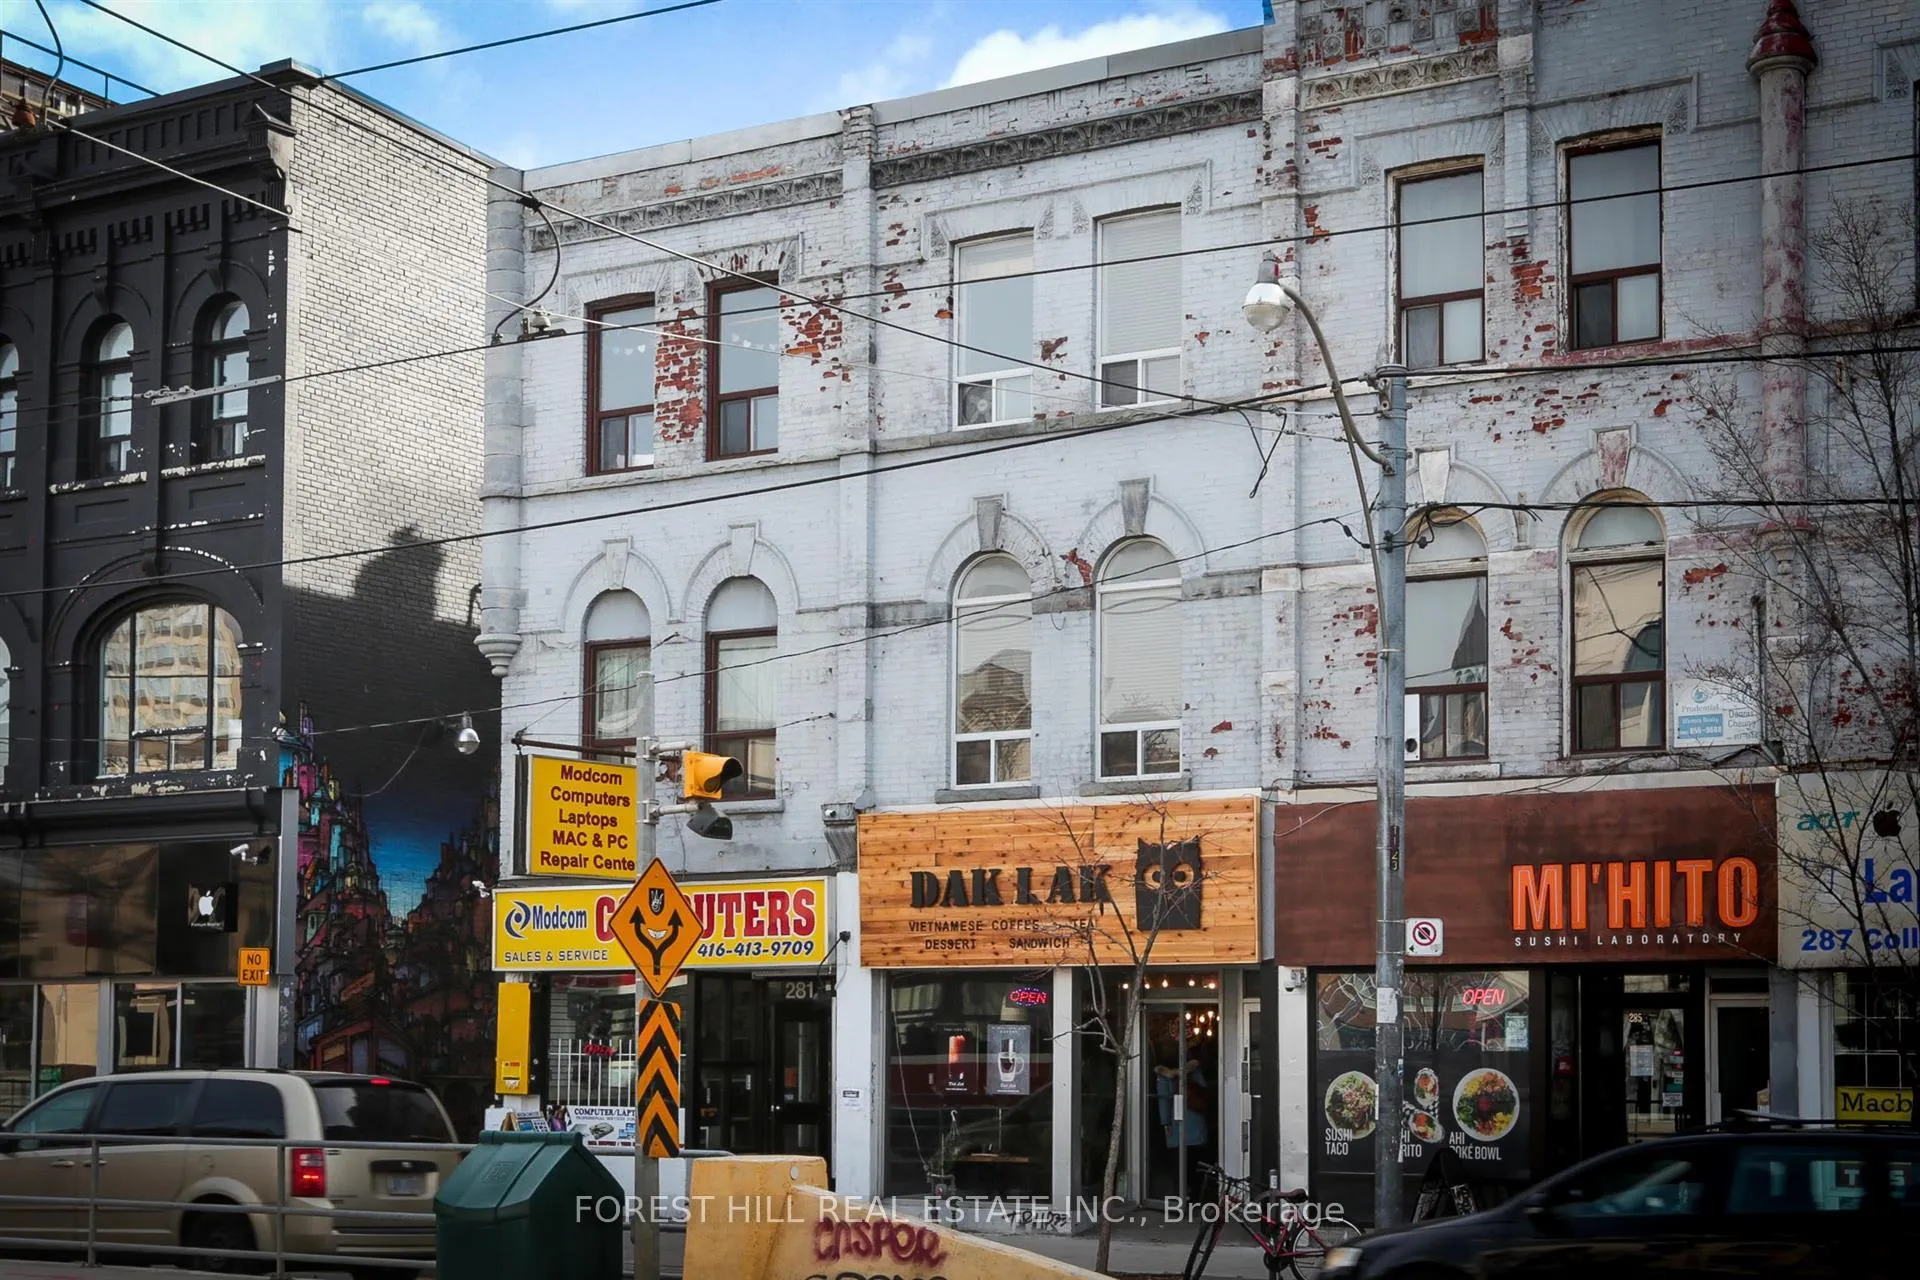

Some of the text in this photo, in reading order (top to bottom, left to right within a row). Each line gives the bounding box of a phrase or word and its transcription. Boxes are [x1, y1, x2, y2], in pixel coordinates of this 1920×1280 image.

[560, 764, 622, 785] Modcom
[550, 785, 631, 807] Computers
[559, 808, 618, 829] Laptops
[552, 830, 628, 849] MAC & PC
[540, 851, 589, 870] Repair
[910, 864, 1113, 908] DAK LAK
[1512, 857, 1758, 931] MI'HITO
[533, 888, 816, 943] Modcom CUTERS
[908, 920, 984, 933] VIETNAMESE
[1072, 918, 1096, 931] TEA
[925, 937, 1070, 950] DESSERT SANDWICH
[1515, 933, 1741, 947] SUSHI LABORATORY
[1801, 928, 1854, 951] 287
[505, 950, 608, 963] SALES & SERVICE
[697, 941, 814, 957] 416-413-9709
[247, 954, 261, 965] NO
[242, 969, 265, 981] EXIT
[785, 980, 814, 999] 281
[1009, 990, 1048, 1004] OPEN
[1462, 989, 1505, 1006] OPEN
[1841, 1091, 1913, 1112] Macb
[1325, 1128, 1353, 1142] SUSHI
[1449, 1131, 1465, 1145] AHI
[1326, 1142, 1349, 1156] TACO
[1449, 1144, 1502, 1161] OKÉ BOWL
